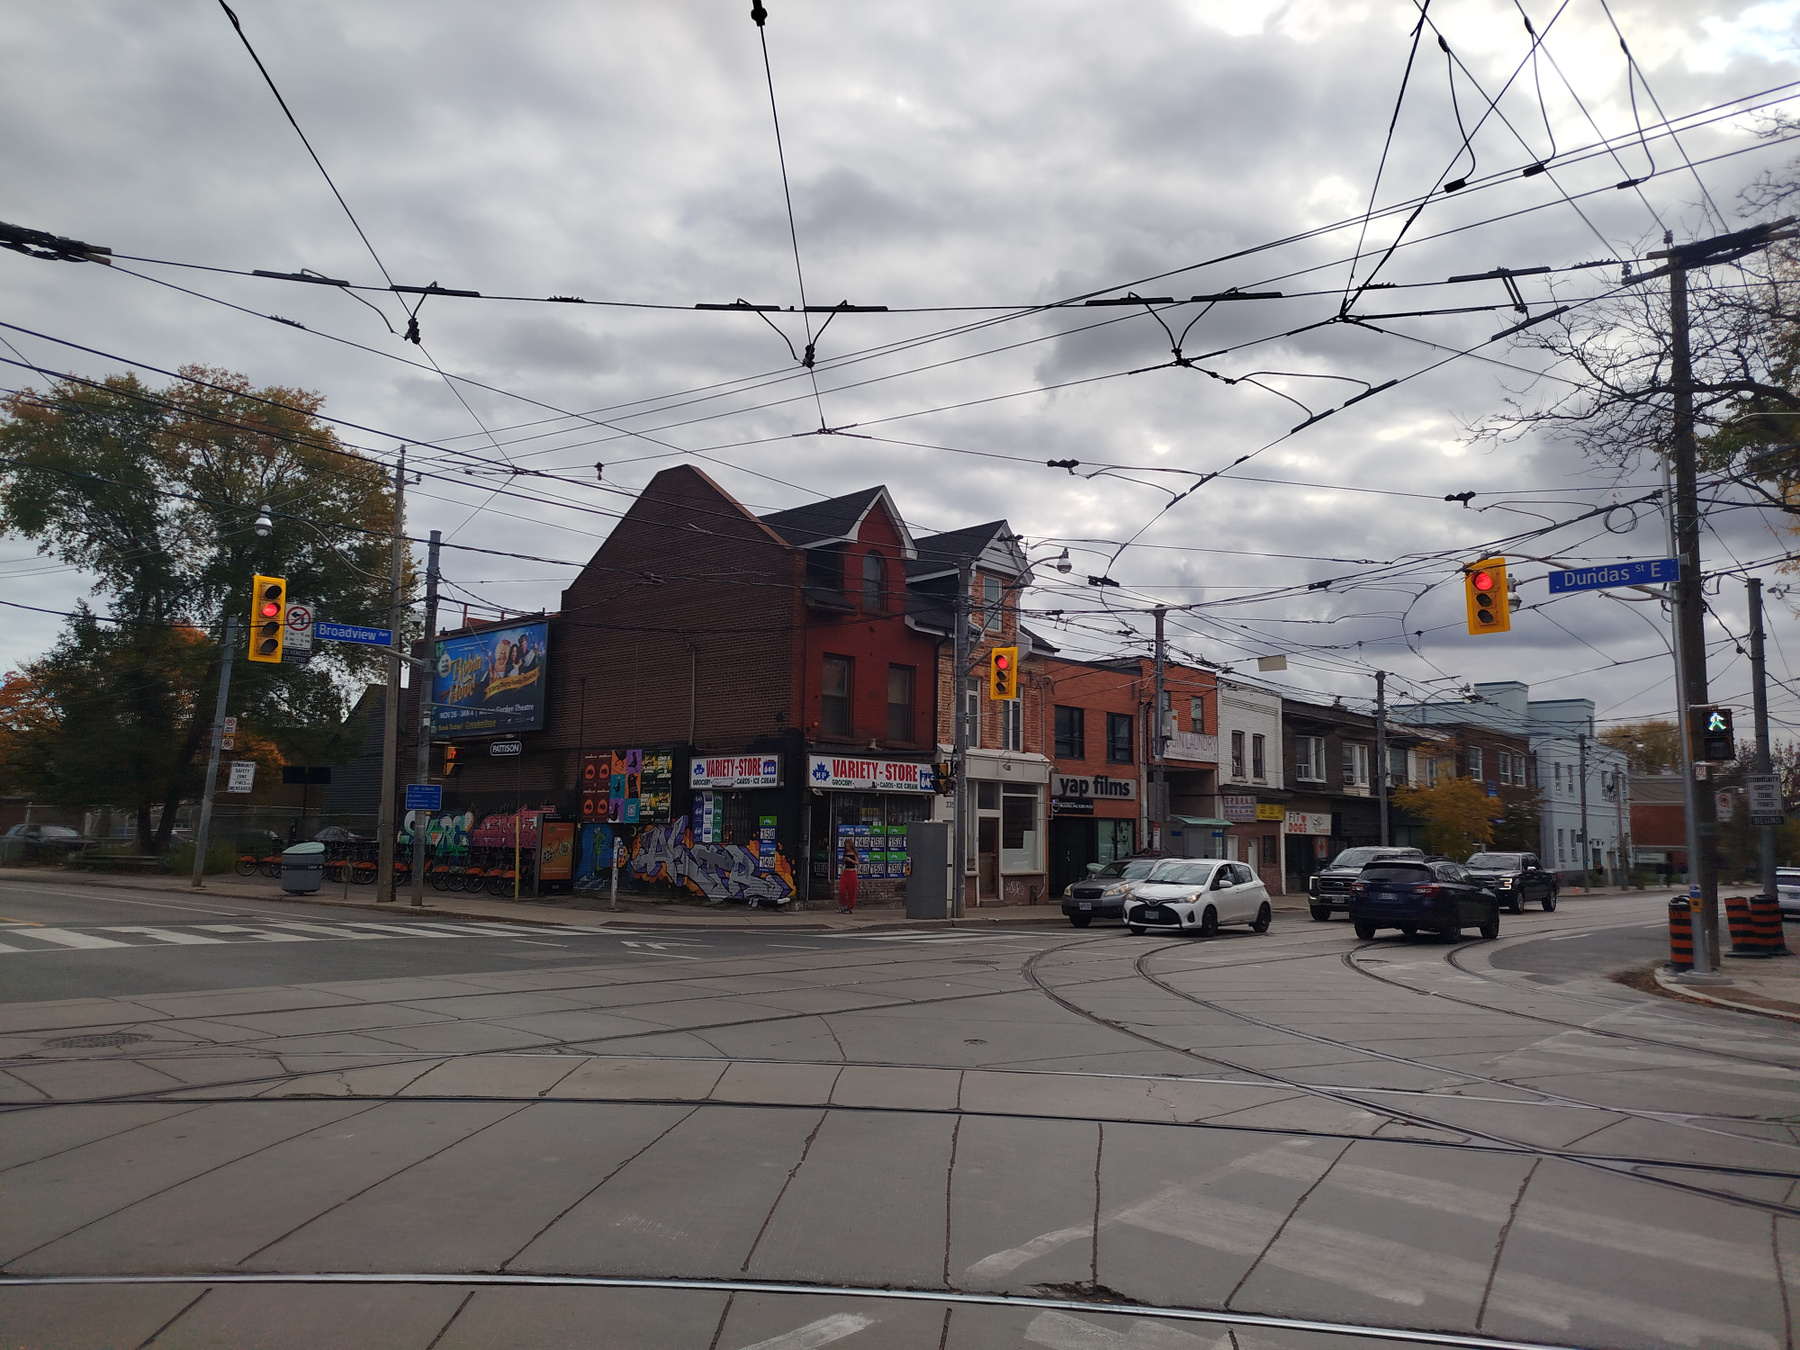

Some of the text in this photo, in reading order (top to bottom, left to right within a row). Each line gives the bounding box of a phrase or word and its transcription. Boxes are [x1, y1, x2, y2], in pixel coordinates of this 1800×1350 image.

[1564, 562, 1662, 587] Dundas St E
[318, 624, 377, 641] Broadview
[450, 653, 482, 682] Robin
[449, 673, 476, 704] Hood
[492, 745, 519, 753] PATTISON
[1059, 774, 1130, 798] yap films
[1288, 812, 1300, 822] FIT
[1288, 822, 1308, 833] DOGS
